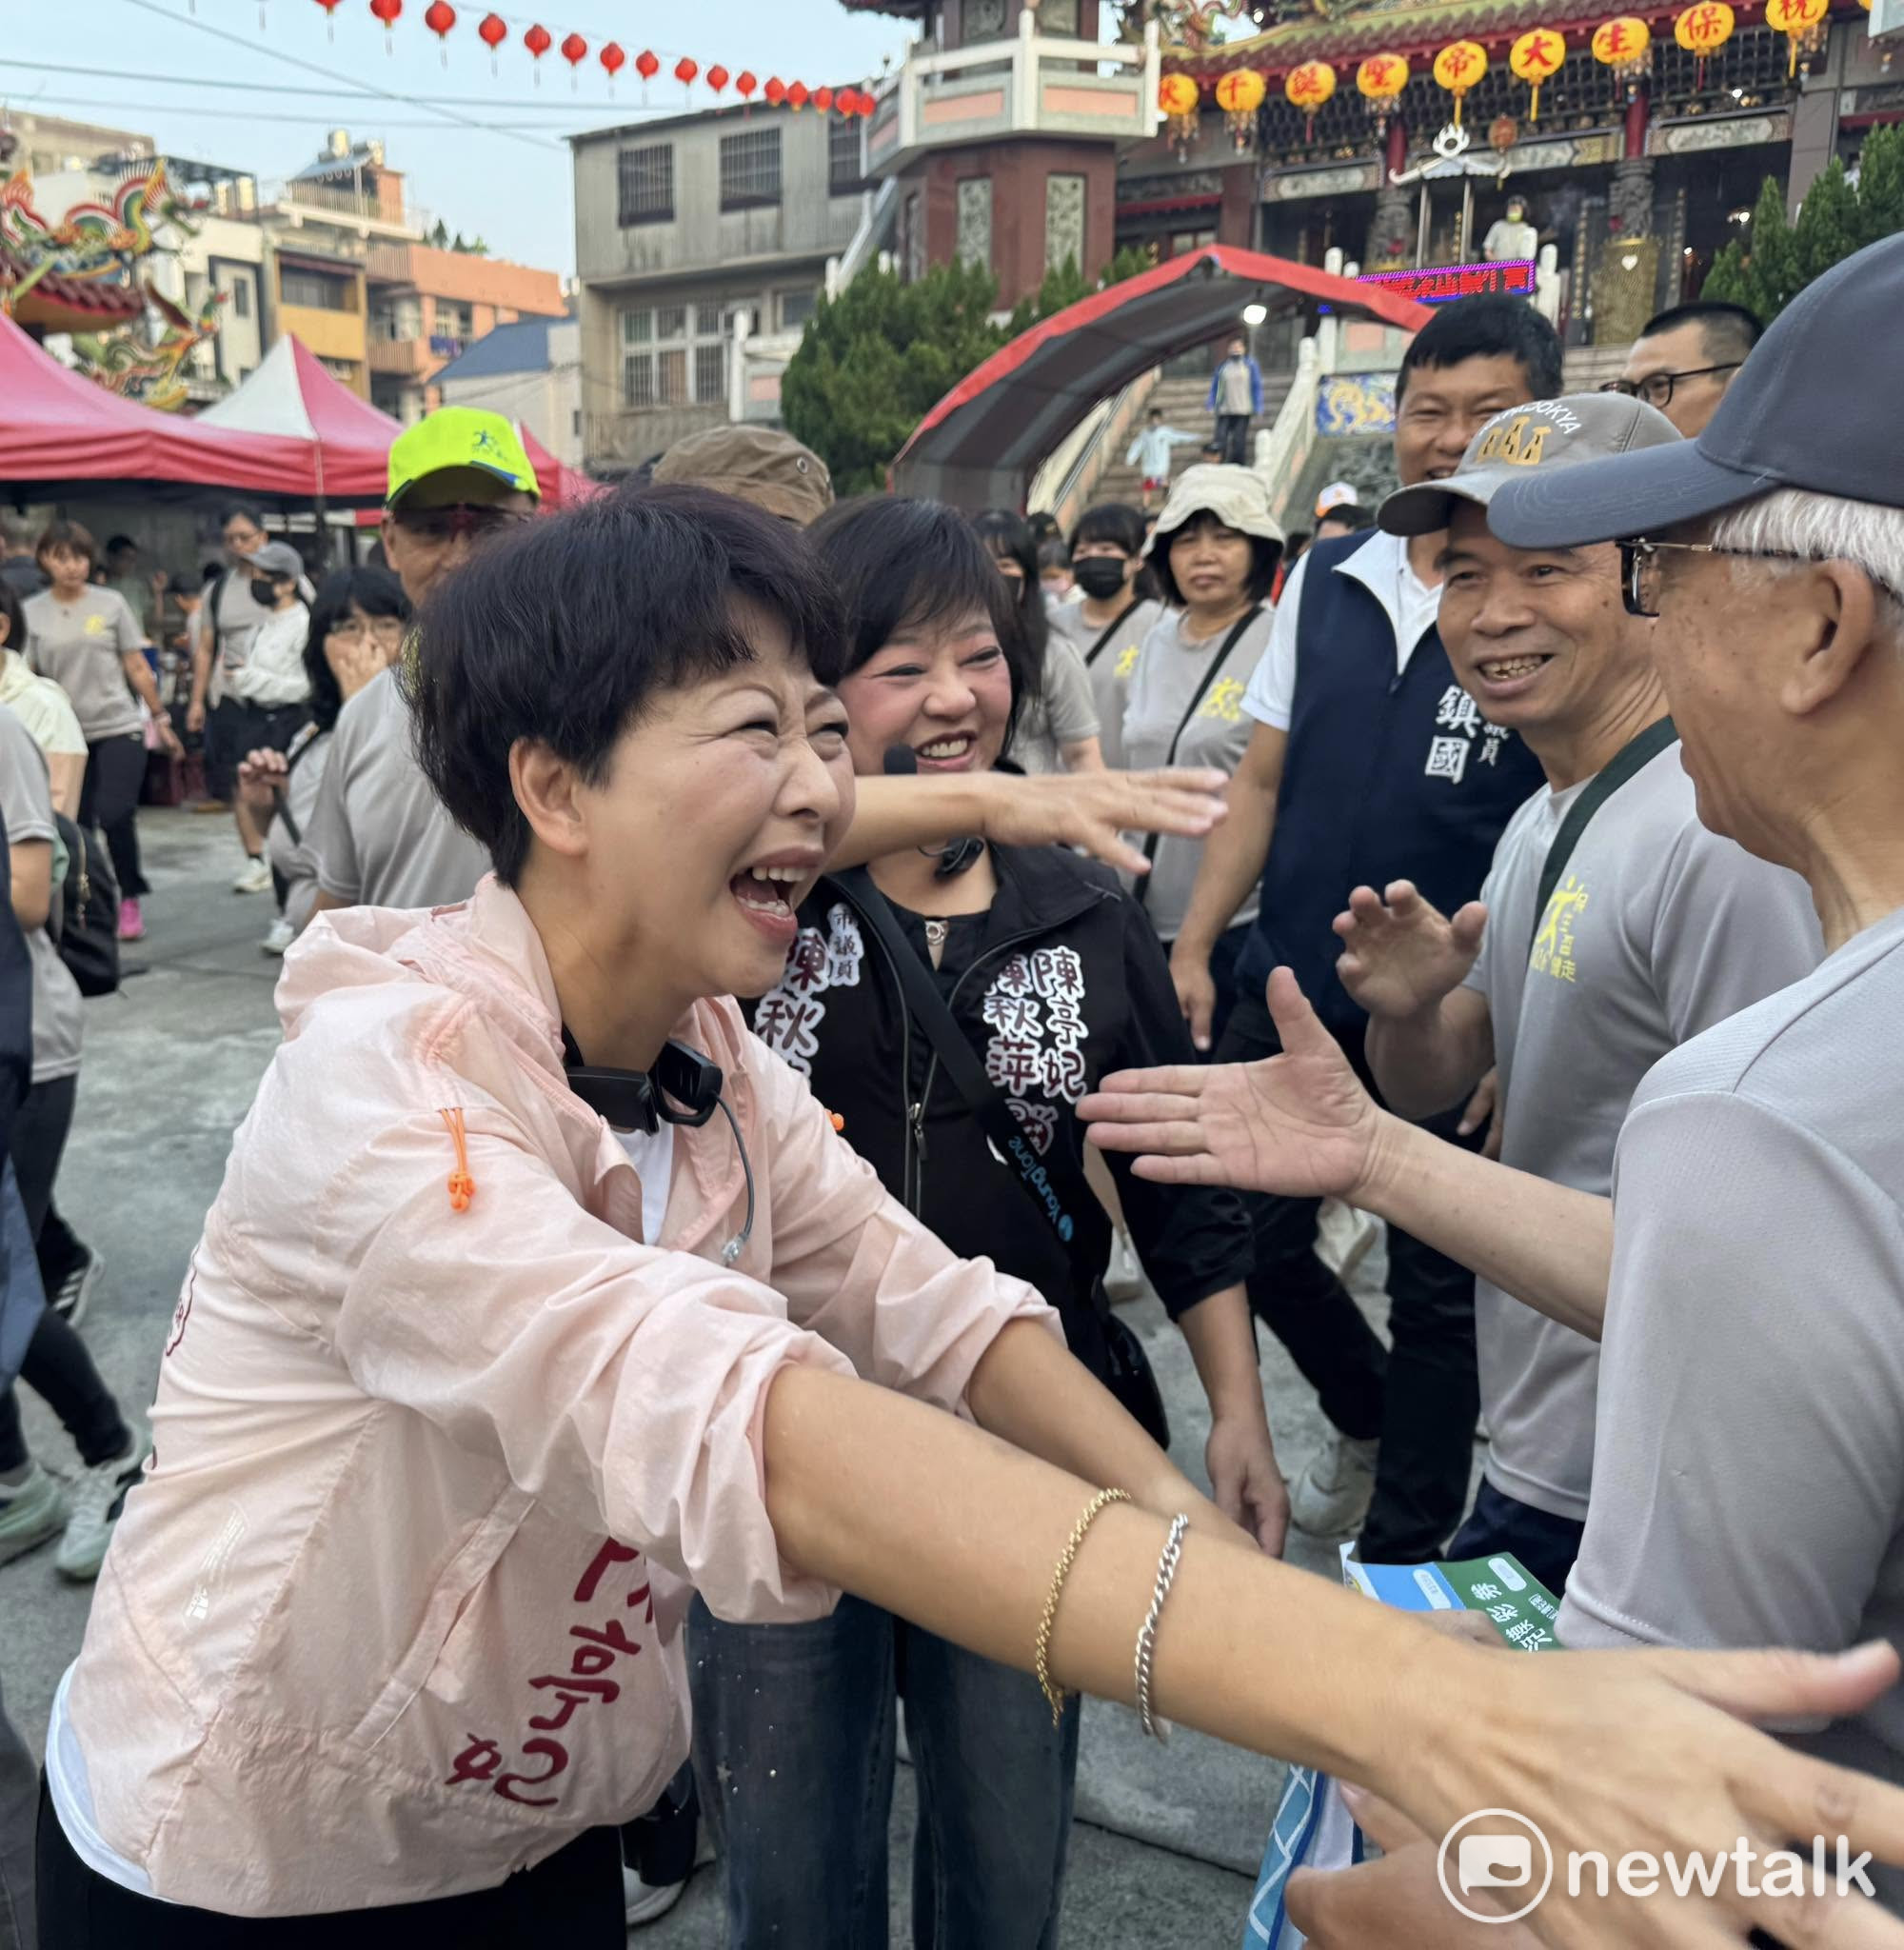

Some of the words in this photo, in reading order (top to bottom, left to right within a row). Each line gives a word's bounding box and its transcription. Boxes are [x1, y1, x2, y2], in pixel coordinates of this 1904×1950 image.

[1597, 23, 1633, 55] 生
[1685, 10, 1723, 42] 保
[1442, 47, 1476, 79] 帝
[1522, 36, 1554, 69] 大
[1222, 75, 1249, 103] 千
[1364, 59, 1395, 89] 聖
[1424, 684, 1482, 785] 鎮國
[756, 929, 832, 1076] 陳秋
[1032, 948, 1087, 1101] 陳亭妃
